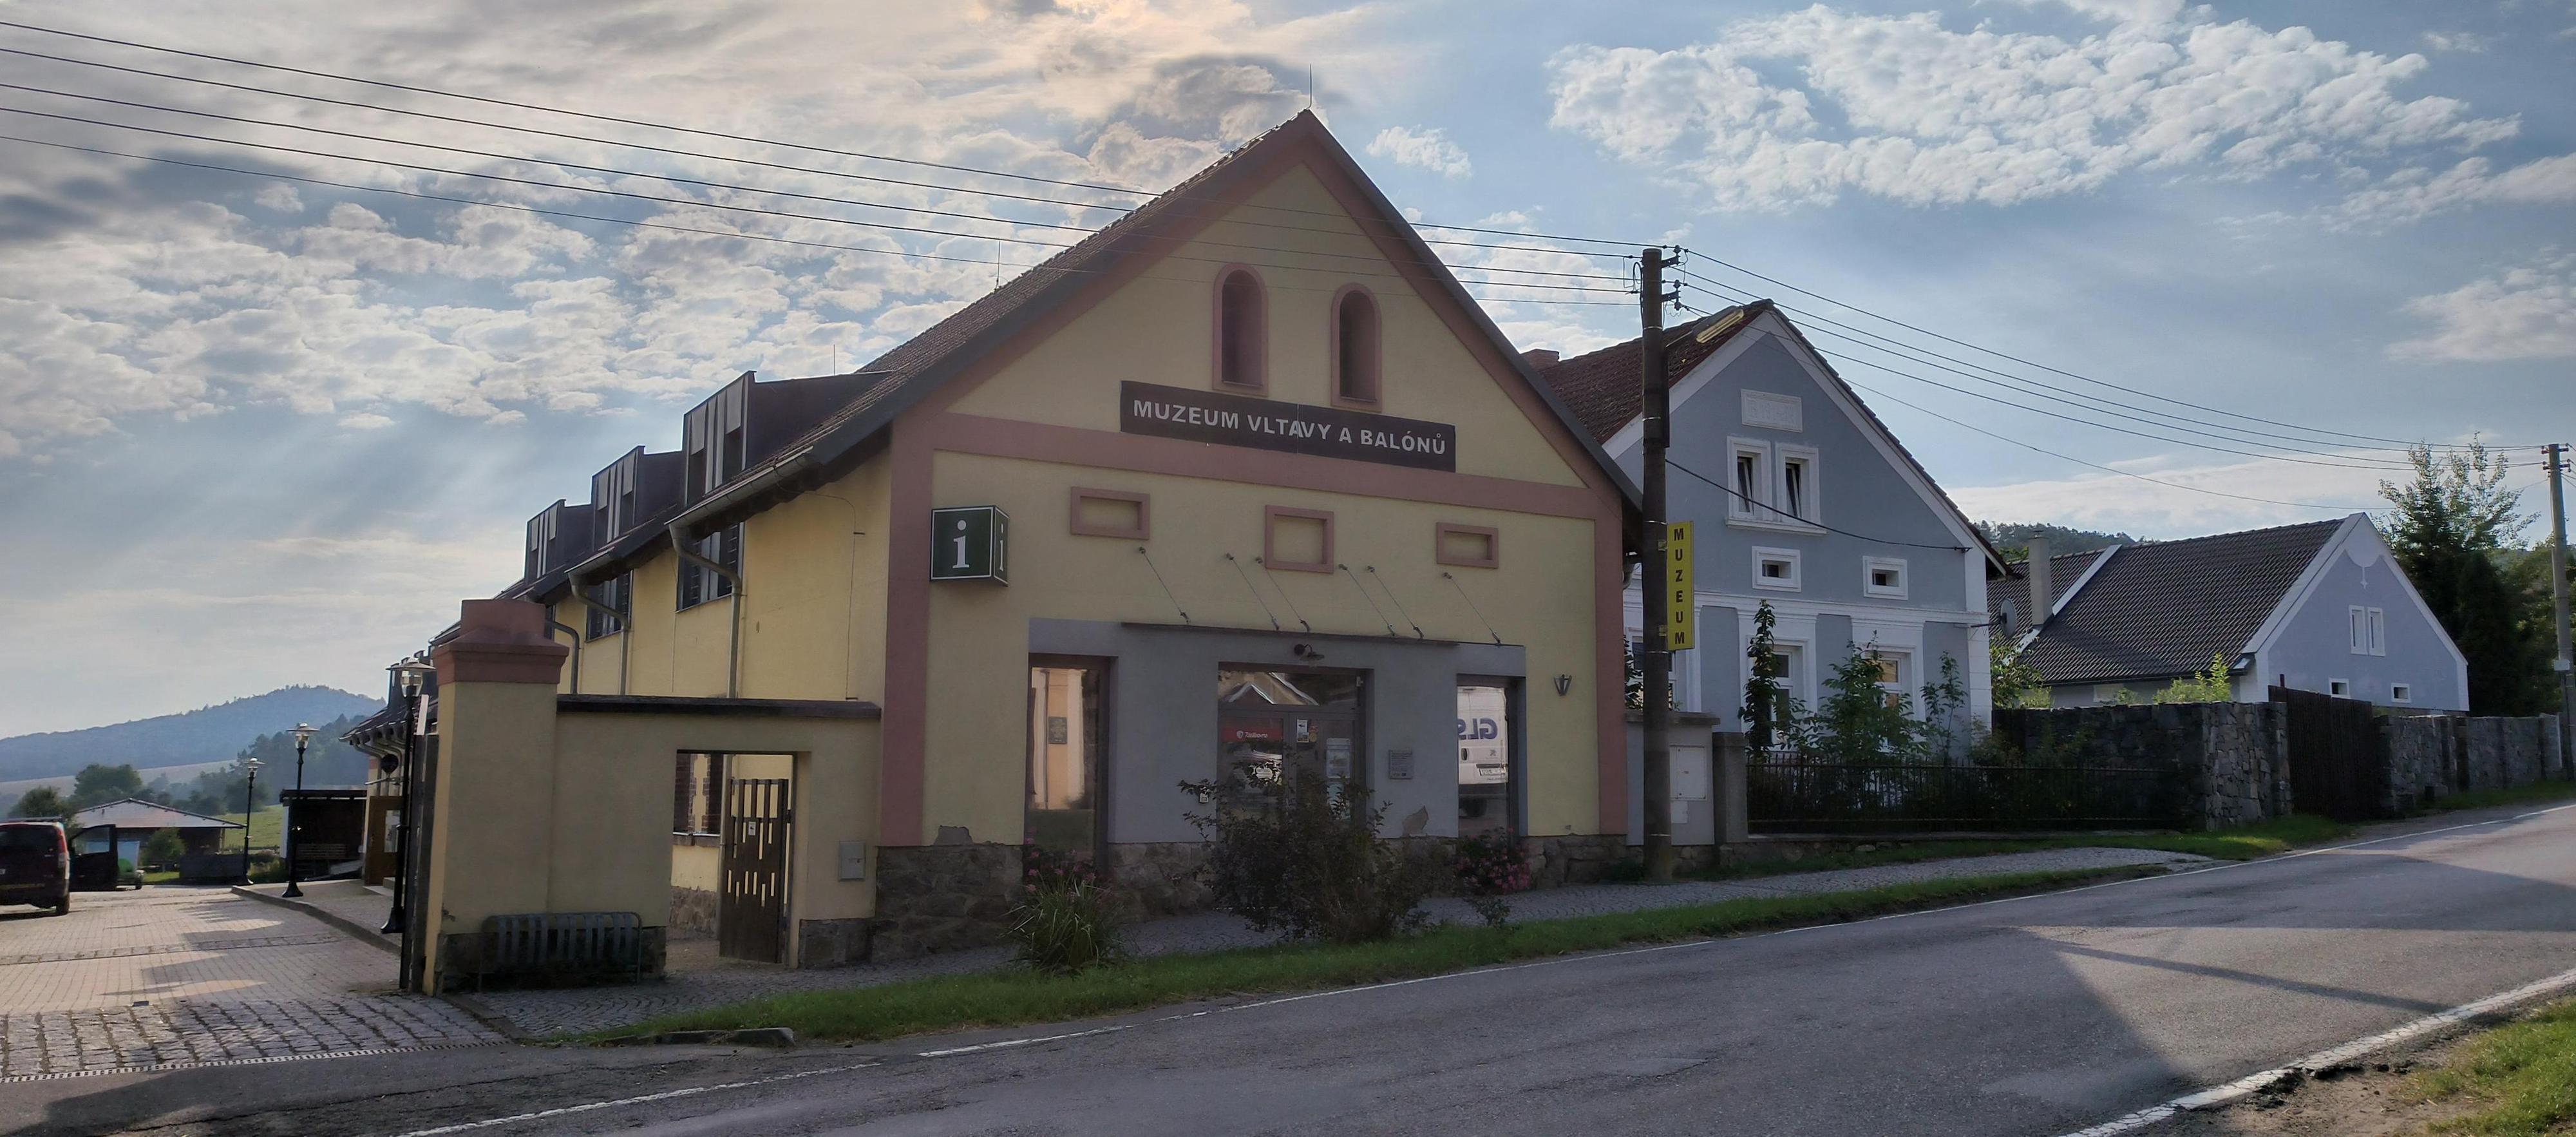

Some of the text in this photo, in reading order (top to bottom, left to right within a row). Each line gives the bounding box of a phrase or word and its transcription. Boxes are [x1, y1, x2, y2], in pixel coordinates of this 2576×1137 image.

[1133, 399, 1446, 455] MUZEUM VLTAVY A BALÓNŮ
[953, 520, 969, 568] i
[1674, 528, 1685, 644] MUZEUM
